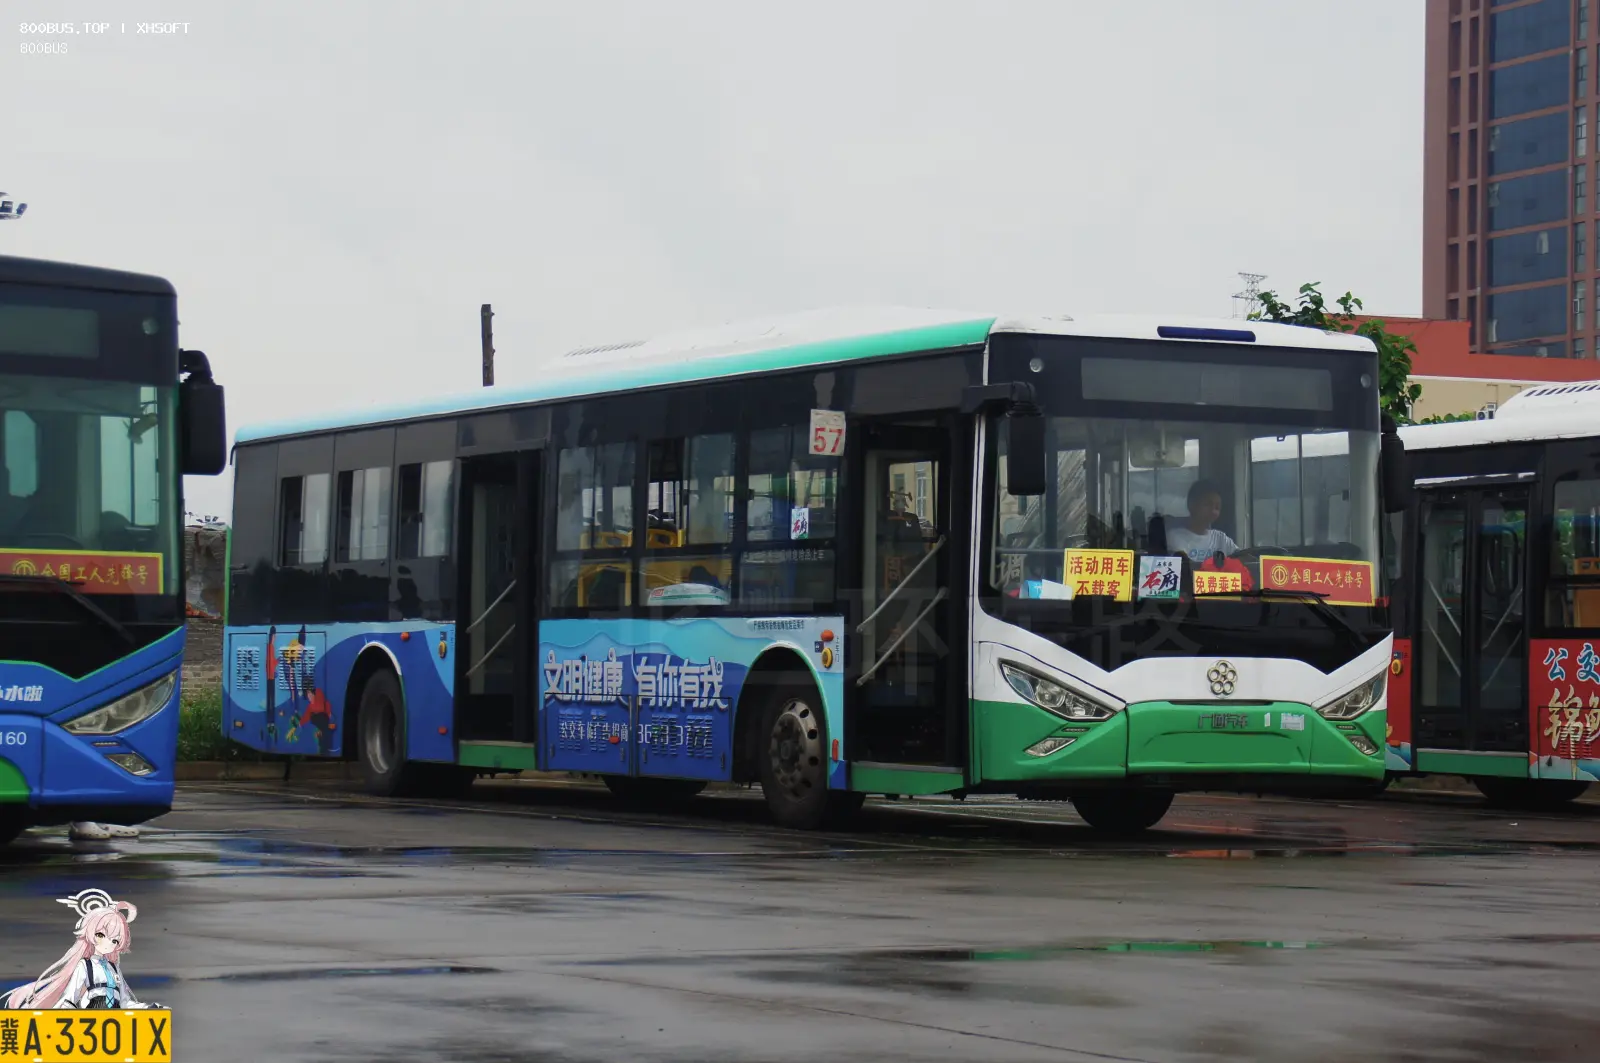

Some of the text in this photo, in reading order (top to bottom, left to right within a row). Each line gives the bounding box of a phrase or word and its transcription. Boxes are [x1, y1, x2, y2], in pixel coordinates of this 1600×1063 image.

[813, 427, 843, 453] 57
[41, 563, 149, 585] 全国工人先锋号
[1069, 556, 1129, 577] 活动用车
[1076, 579, 1121, 597] 不载客
[1195, 576, 1242, 594] 免费乘车
[1290, 568, 1363, 588] 全国工人先锋号
[543, 648, 728, 709] 文明健康 有你有我
